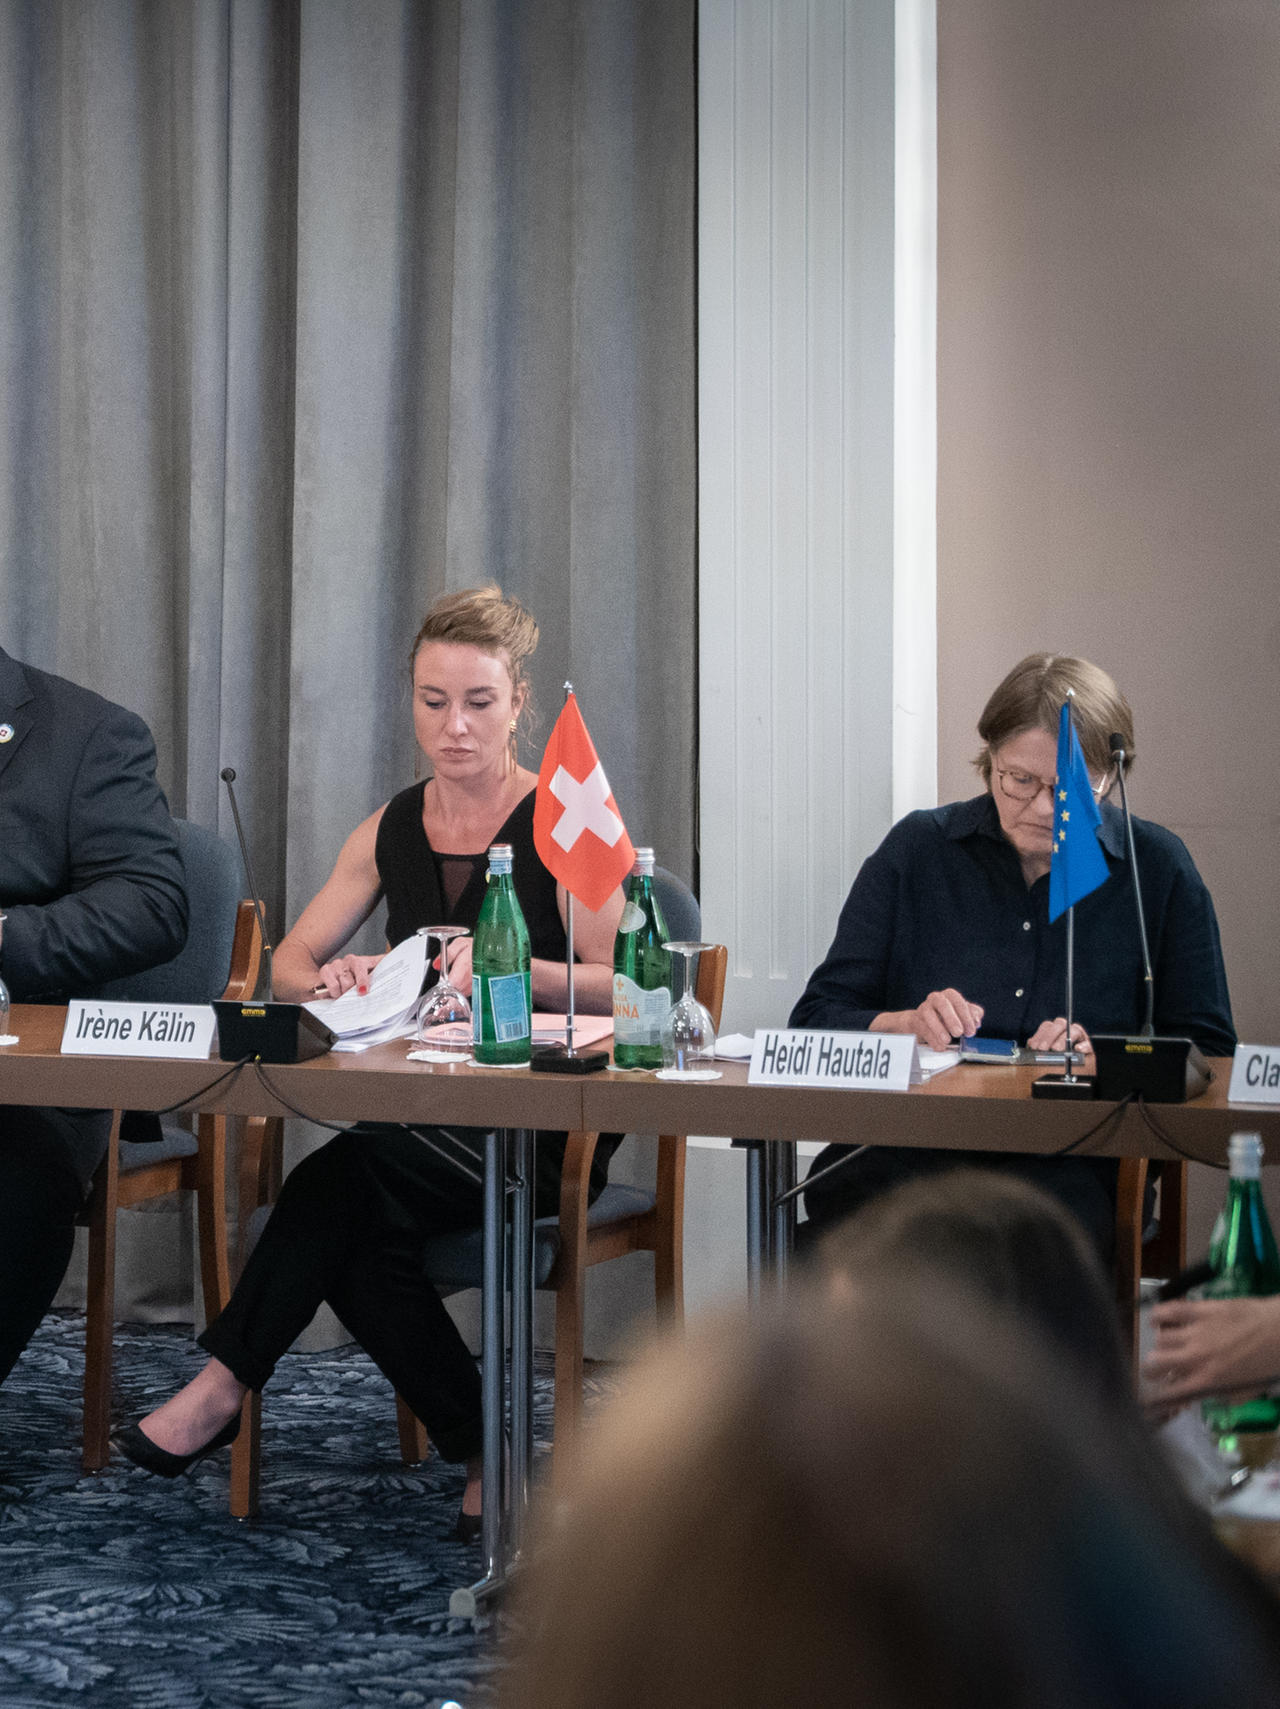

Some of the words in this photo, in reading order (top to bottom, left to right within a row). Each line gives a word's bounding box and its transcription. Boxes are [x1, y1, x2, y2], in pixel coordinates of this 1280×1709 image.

[76, 1008, 133, 1040] Irène
[137, 1010, 196, 1042] Kälin
[761, 1033, 814, 1075] Heidi
[816, 1036, 891, 1079] Hautala
[1246, 1053, 1280, 1087] Cla
